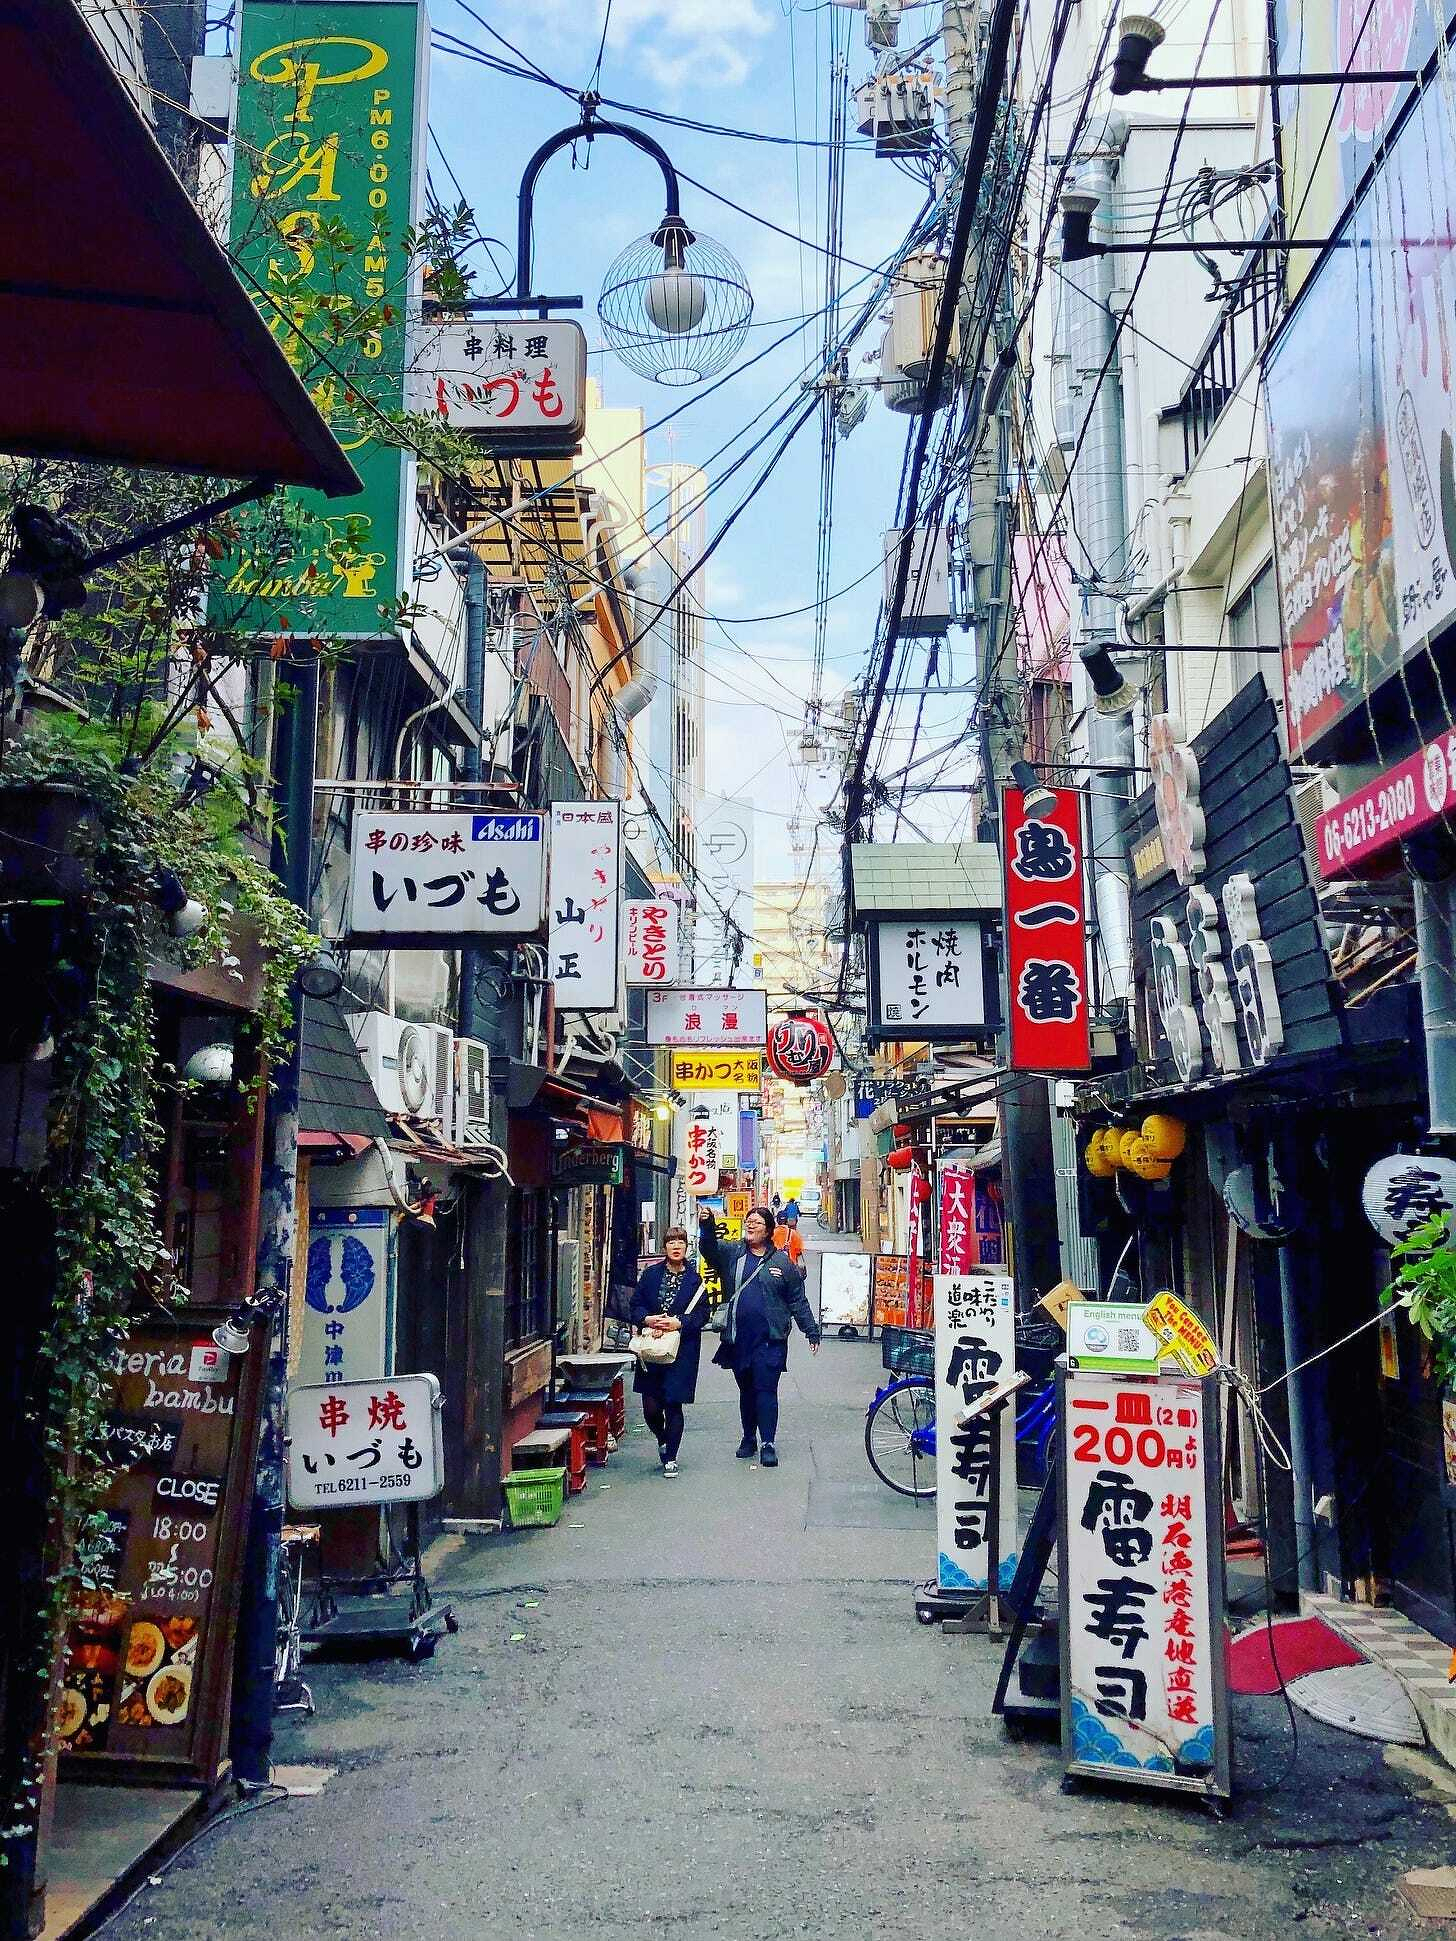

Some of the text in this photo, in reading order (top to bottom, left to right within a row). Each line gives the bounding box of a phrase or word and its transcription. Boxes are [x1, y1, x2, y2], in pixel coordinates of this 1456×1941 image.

[463, 334, 549, 361] 串料理
[436, 367, 563, 418] いづも
[364, 828, 466, 855] 串の珍味
[477, 817, 535, 841] Asahi
[371, 866, 521, 916] いづも
[554, 896, 586, 980] 山正
[642, 906, 668, 981] やきとり
[931, 929, 962, 989] 焼肉
[905, 928, 930, 1020] ホルモン
[675, 1061, 732, 1081] 串かつ
[687, 1124, 707, 1186] 串かつ
[947, 1283, 968, 1330] 道楽
[962, 1287, 982, 1318] 味の
[980, 1280, 997, 1328] こだわり
[1083, 1309, 1117, 1321] English
[144, 1379, 234, 1415] bambu
[320, 1391, 407, 1438] 串焼
[1073, 1393, 1153, 1425] 一皿
[302, 1438, 423, 1474] いづも
[946, 1335, 1003, 1550] 雷寿司
[157, 1477, 219, 1505] CLOSE
[153, 1516, 207, 1542] 18:00
[1081, 1469, 1158, 1722] 雷寿司
[1159, 1493, 1200, 1726] 明石漁港産地直送
